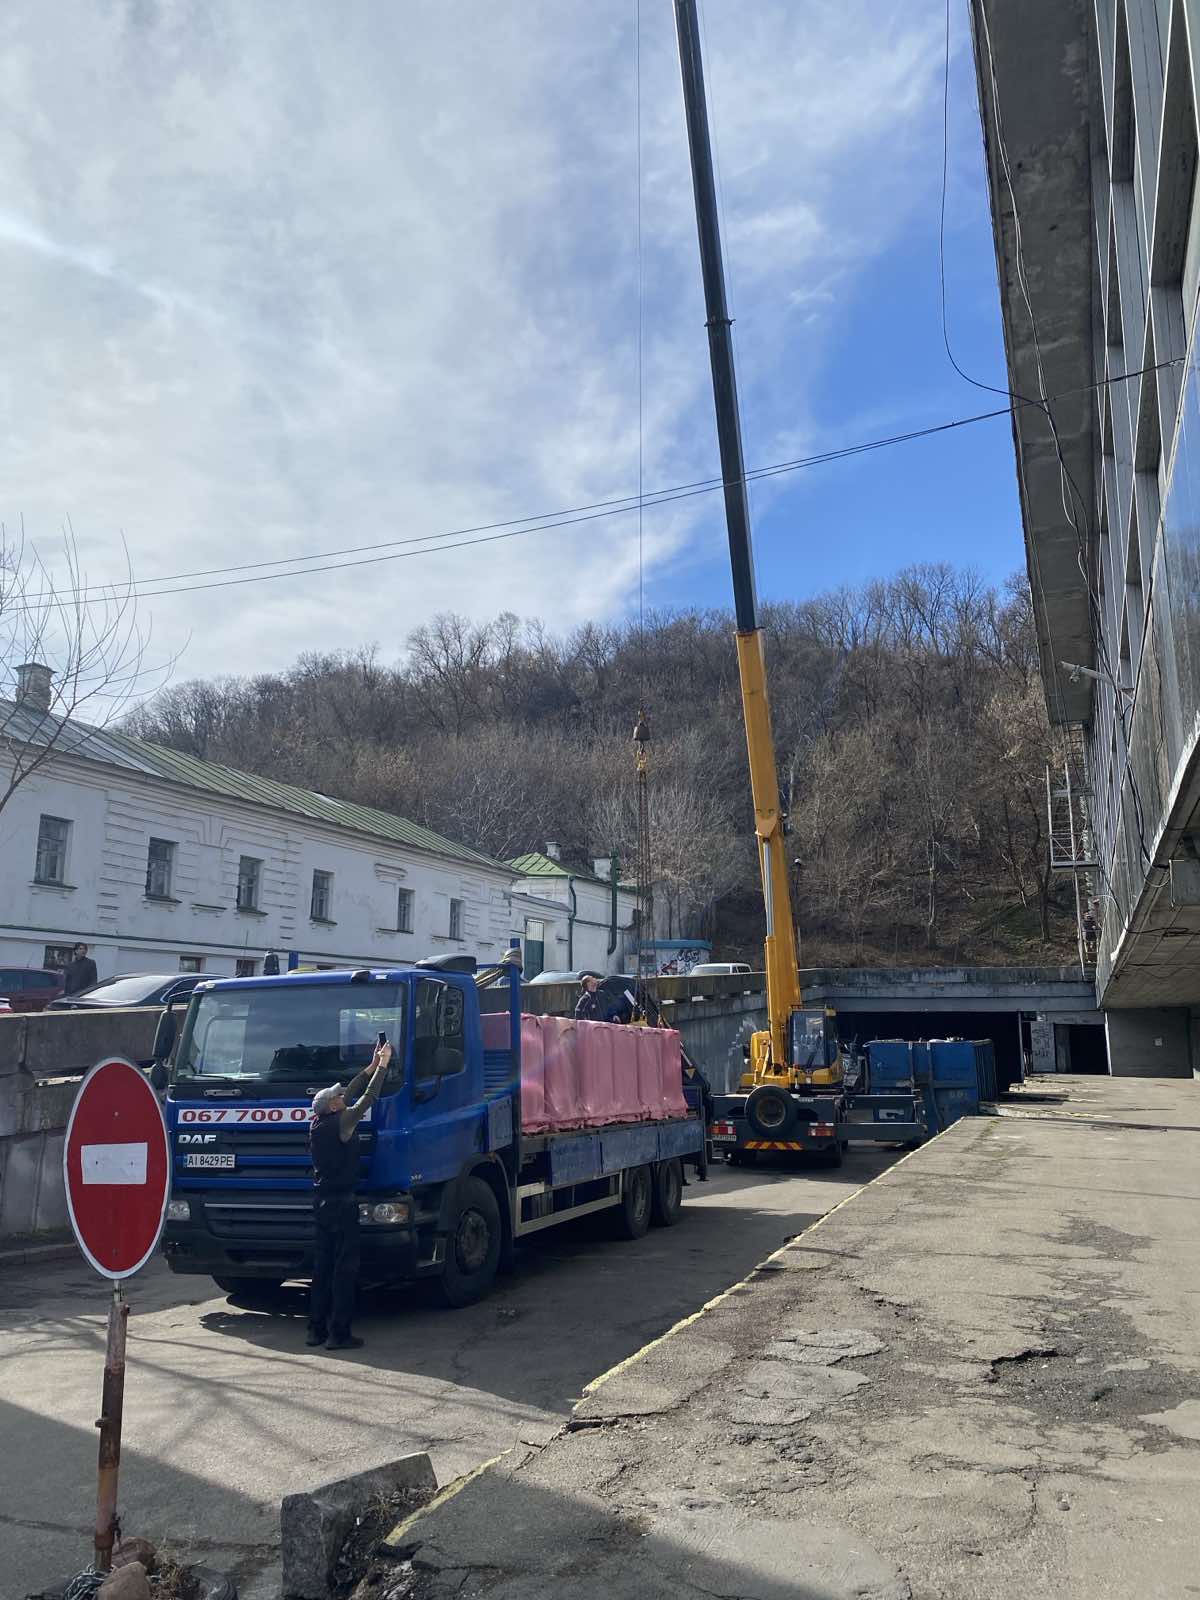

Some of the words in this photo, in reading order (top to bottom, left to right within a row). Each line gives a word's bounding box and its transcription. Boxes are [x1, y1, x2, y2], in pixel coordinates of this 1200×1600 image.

[182, 1110, 228, 1122] 067
[236, 1109, 283, 1122] 700
[178, 1134, 217, 1144] DAF
